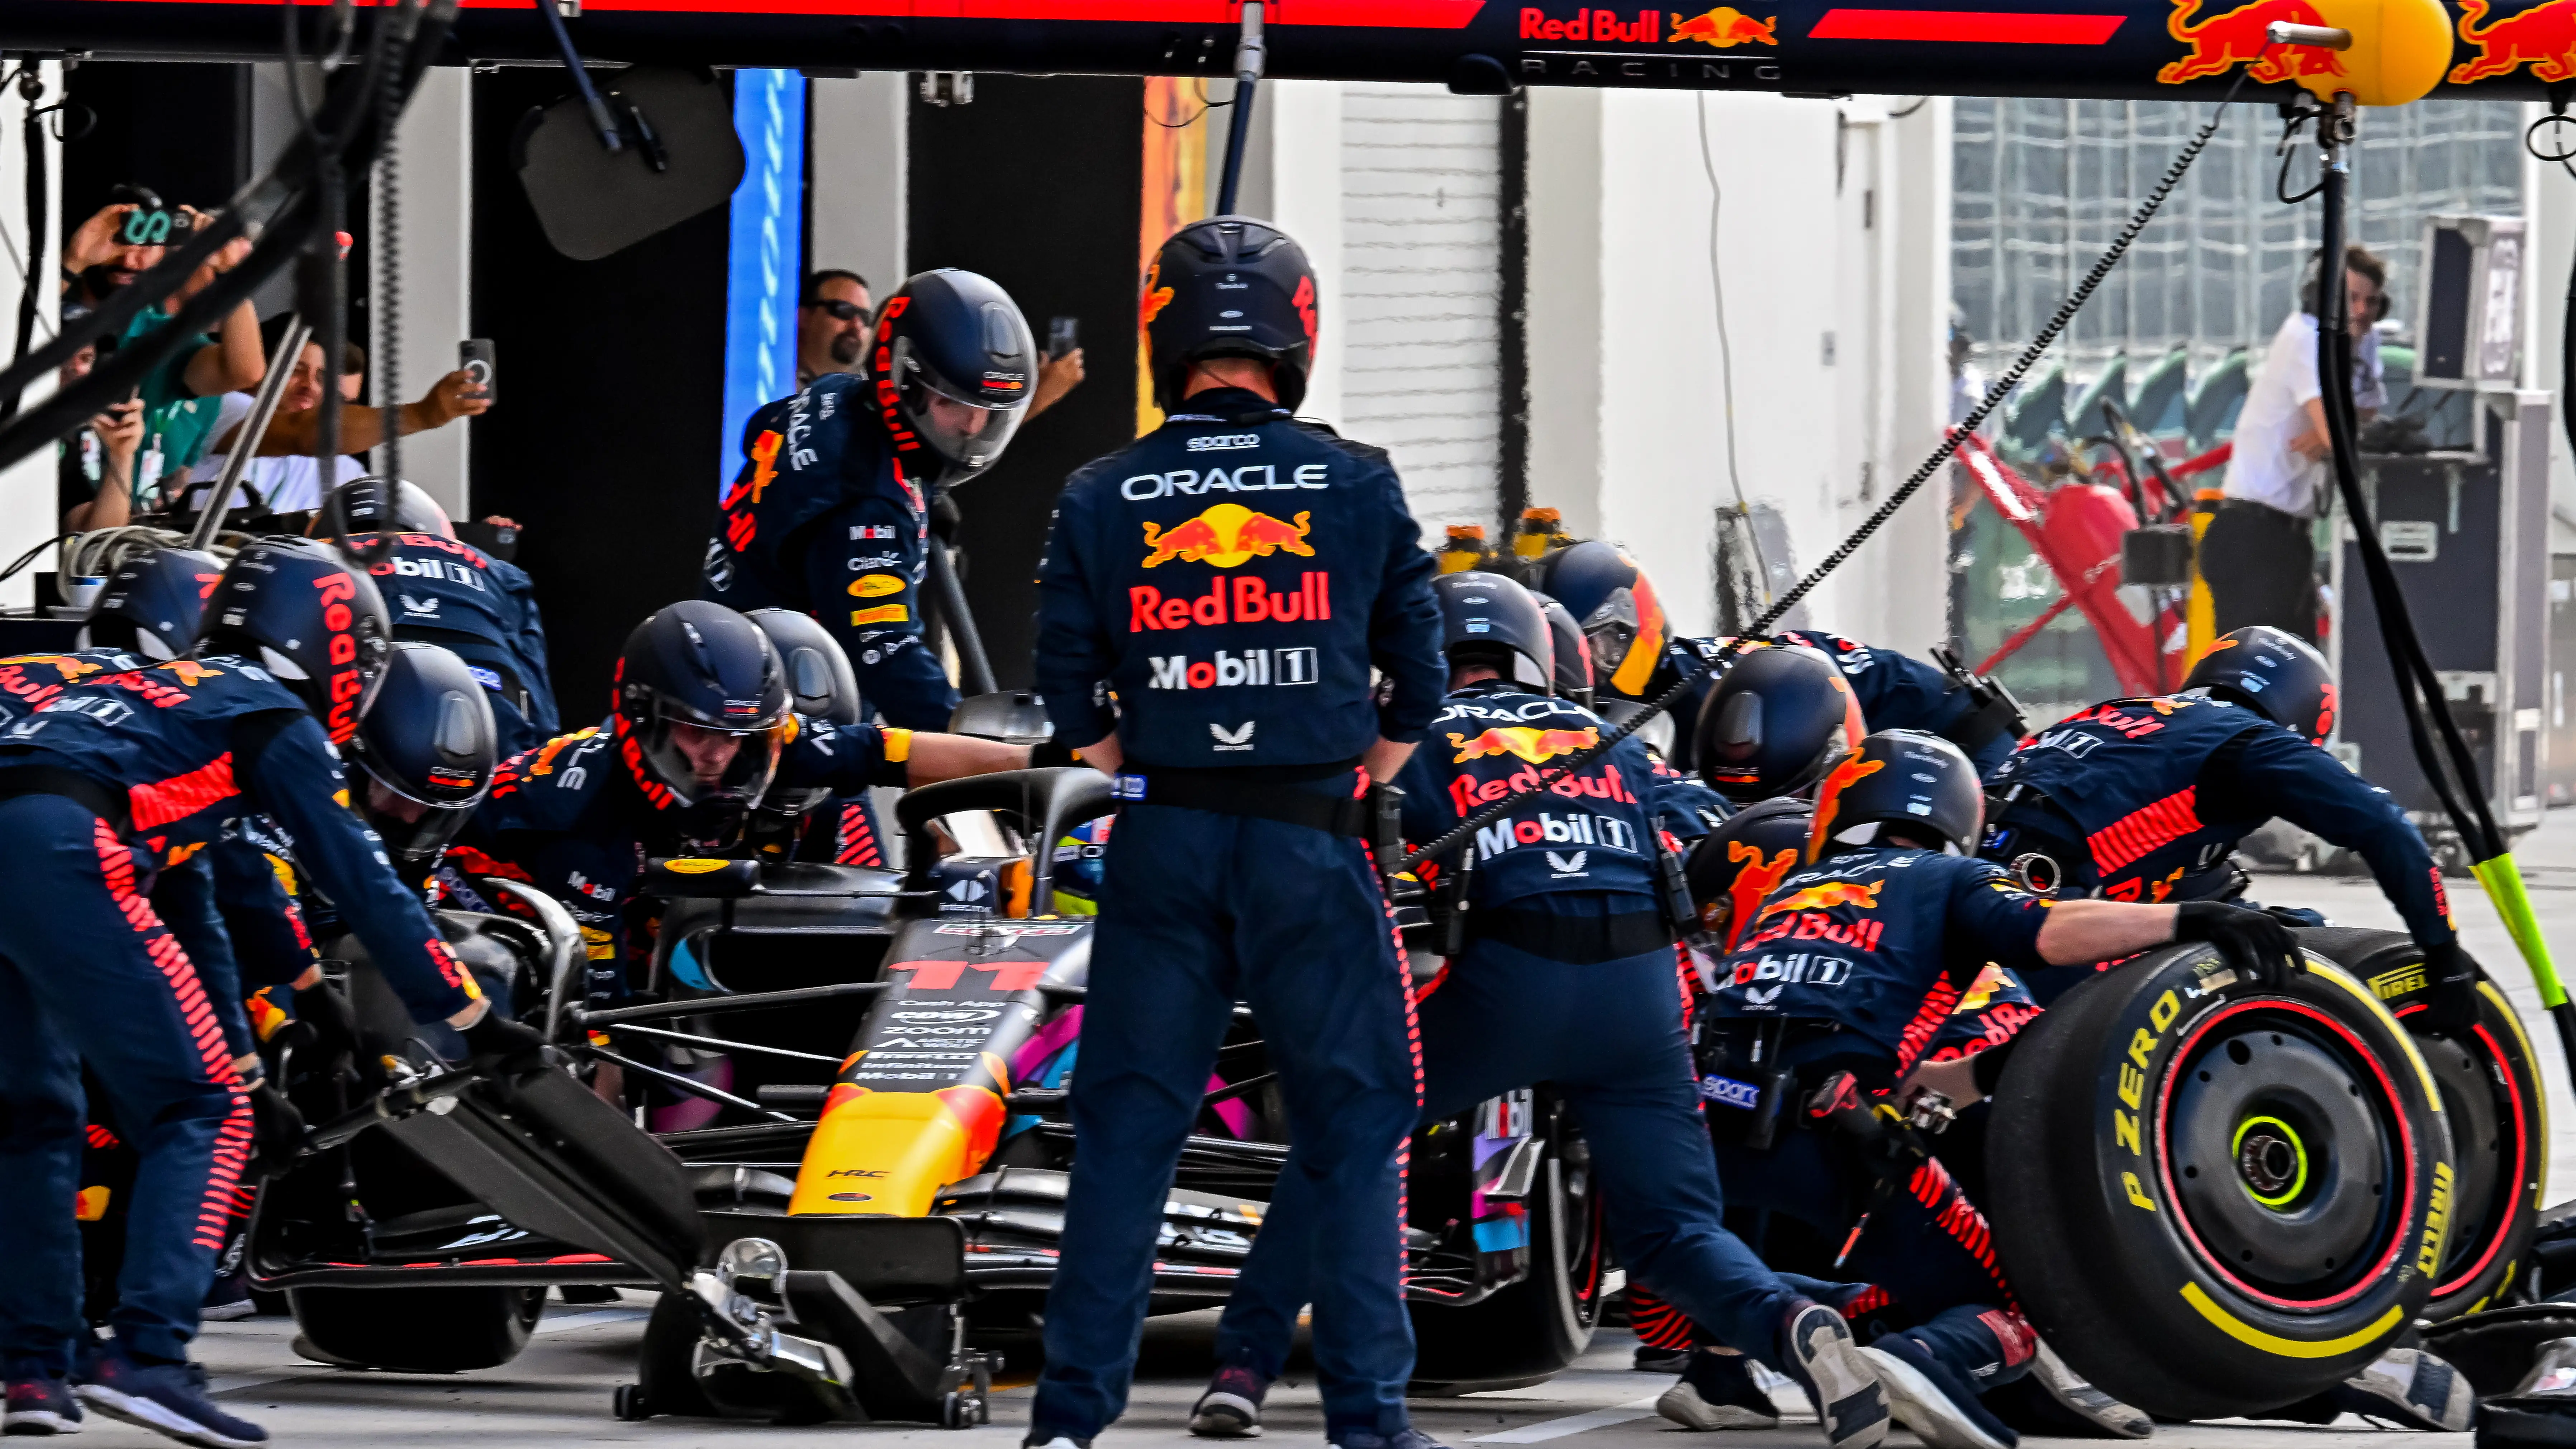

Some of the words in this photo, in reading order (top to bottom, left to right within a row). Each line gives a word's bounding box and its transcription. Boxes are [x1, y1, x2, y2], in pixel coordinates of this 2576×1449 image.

[1520, 8, 1589, 41] Red
[1593, 10, 1659, 43] Bull
[1520, 59, 1781, 80] RACING
[1186, 433, 1260, 451] sparco
[1120, 464, 1329, 501] ORACLE
[849, 525, 896, 540] Mobil
[368, 556, 445, 579] obil
[313, 573, 356, 665] Red
[1129, 576, 1227, 633] Red
[1233, 571, 1331, 623] Bull
[1149, 649, 1270, 690] Mobil
[1431, 701, 1605, 725] ORACL
[1448, 763, 1543, 818] Red
[1475, 812, 1595, 861] Mobil
[1792, 913, 1884, 952] Bull
[889, 960, 1050, 991] 11
[2366, 963, 2429, 1000] PIREL
[881, 1026, 993, 1035] zoom
[2114, 989, 2182, 1156] ZERO
[826, 1169, 891, 1178] HRC
[2121, 1171, 2156, 1211] P
[2416, 1161, 2455, 1279] PIRELLI
